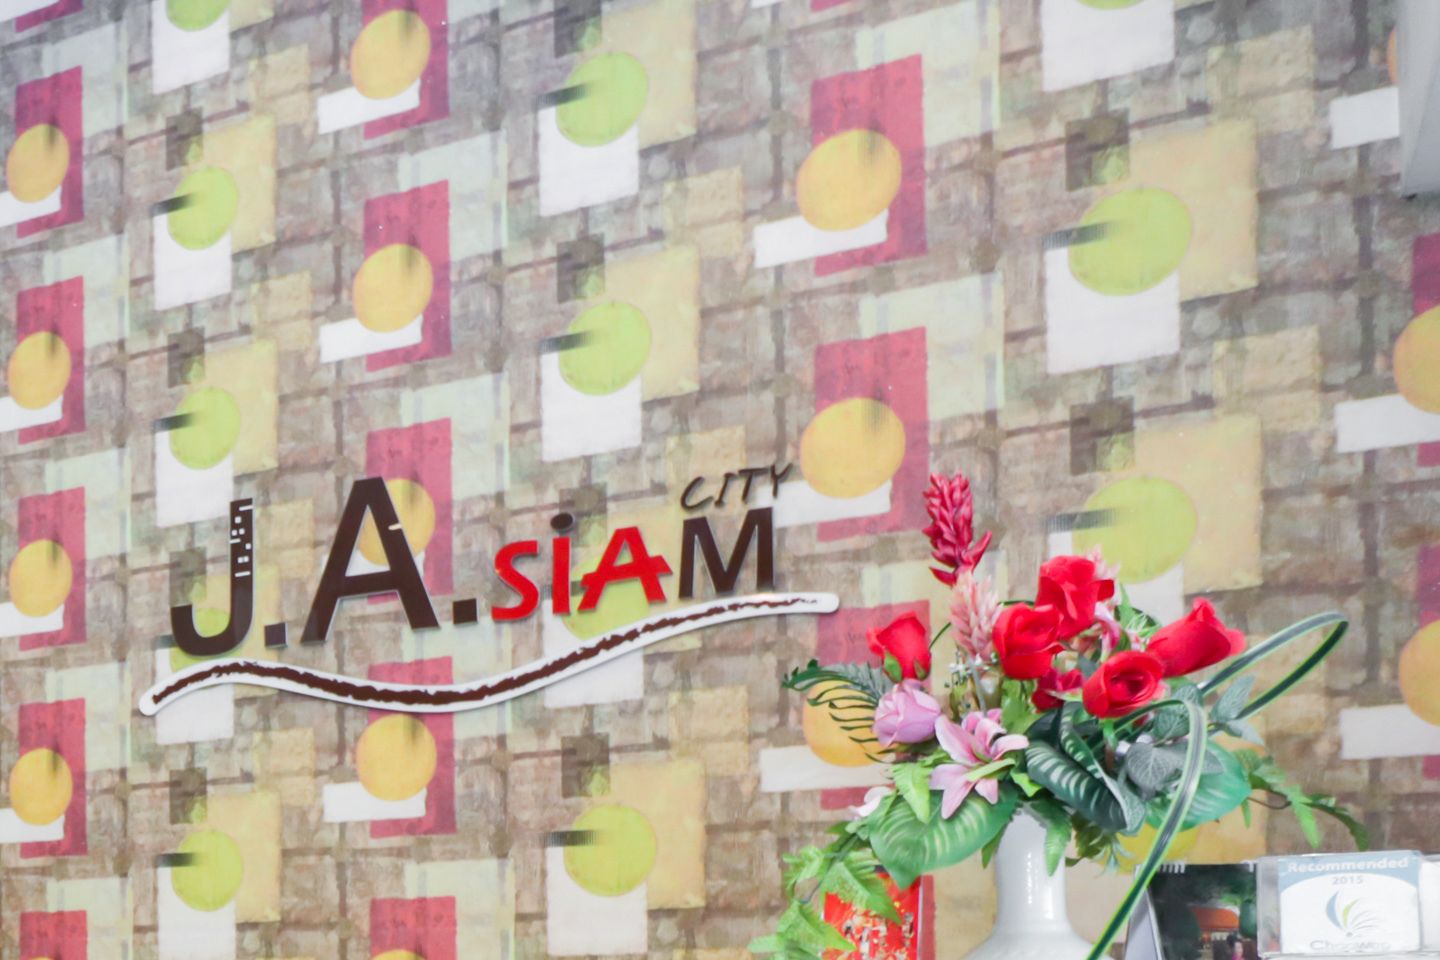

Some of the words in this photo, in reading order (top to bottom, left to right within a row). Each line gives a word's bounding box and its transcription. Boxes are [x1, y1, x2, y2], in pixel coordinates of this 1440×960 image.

[681, 462, 792, 510] CITY
[1287, 856, 1410, 873] Recommended
[1332, 875, 1364, 886] 2015
